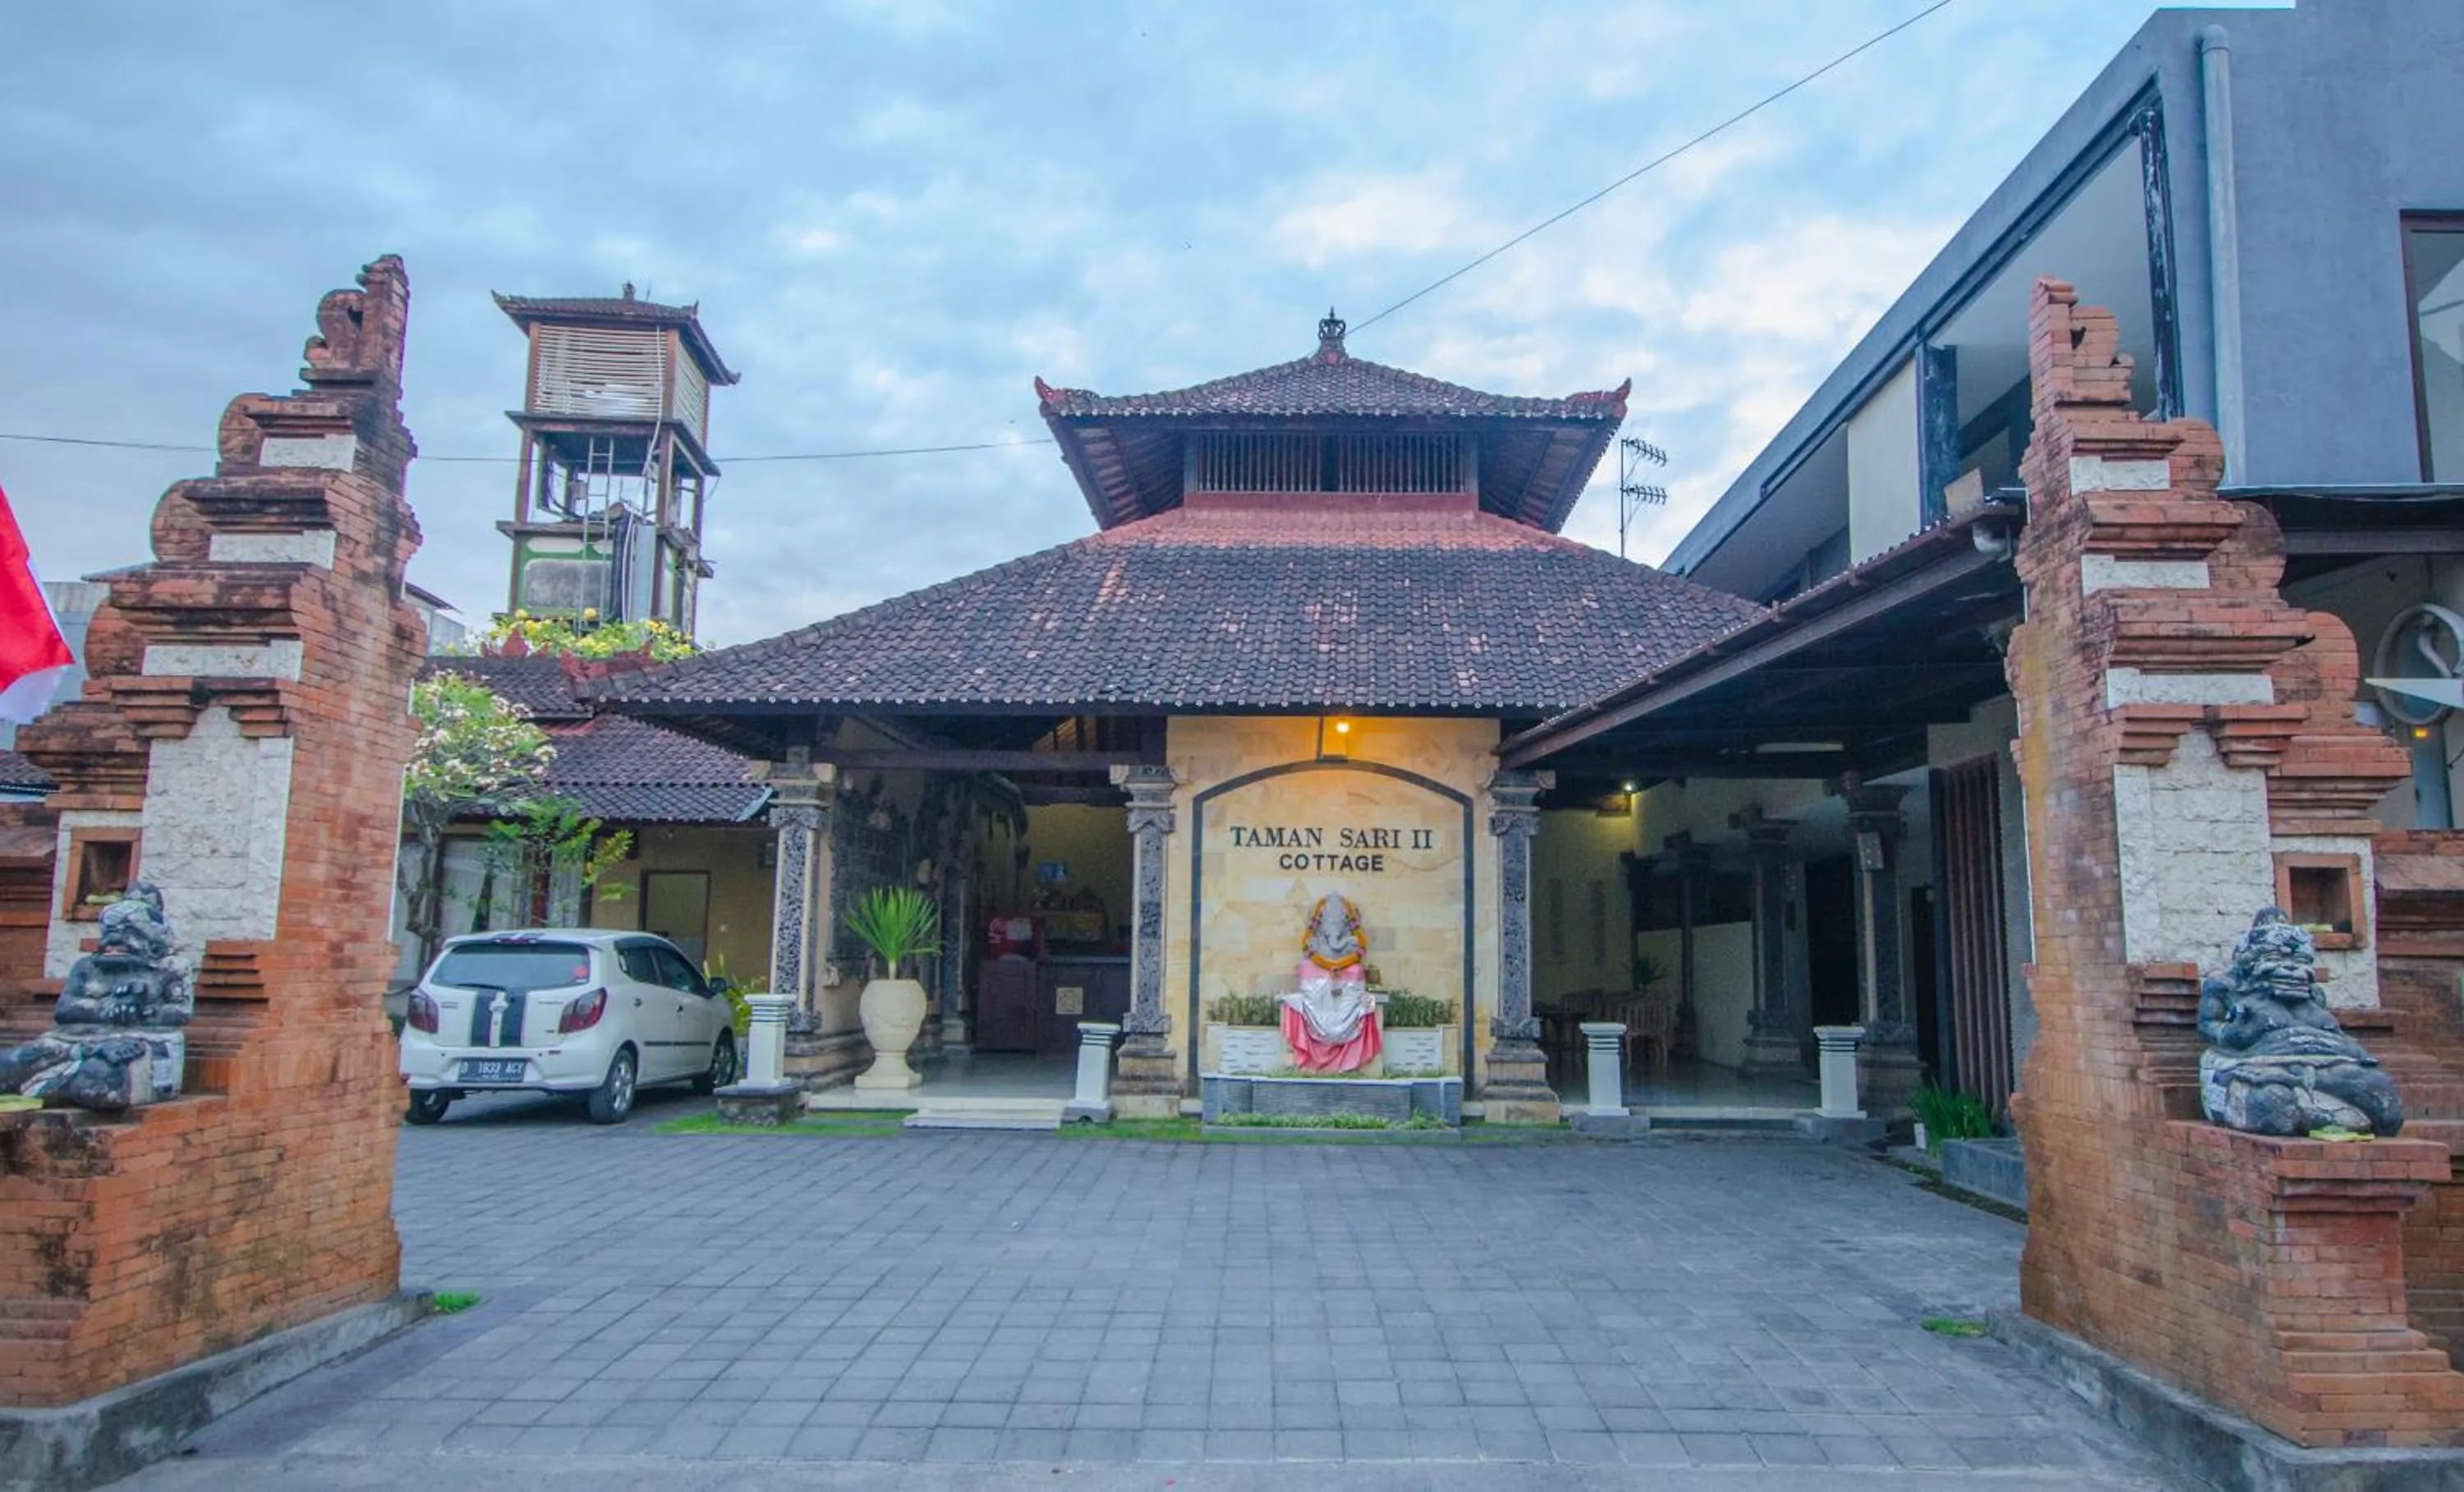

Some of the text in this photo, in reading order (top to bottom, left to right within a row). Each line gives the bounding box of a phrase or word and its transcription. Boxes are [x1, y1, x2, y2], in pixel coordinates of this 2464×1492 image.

[1230, 826, 1433, 850] TAMAN SARI II
[1279, 853, 1384, 873] COTTAGE
